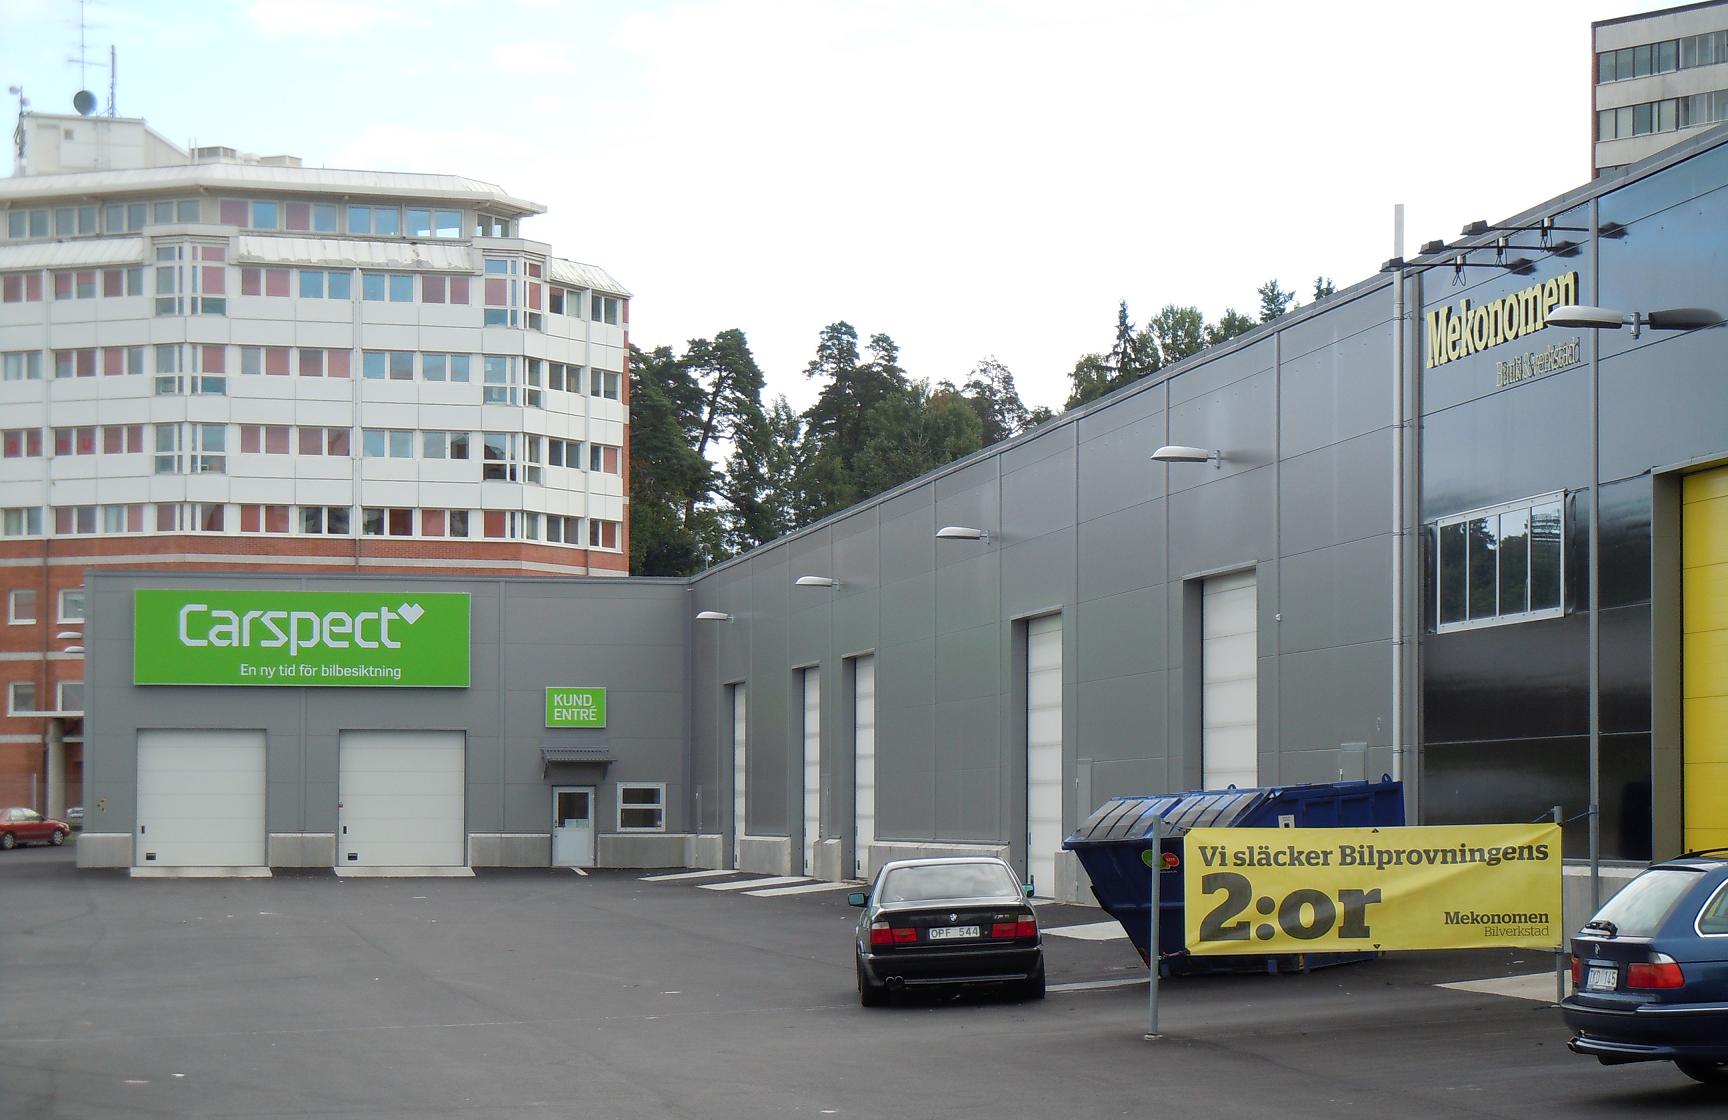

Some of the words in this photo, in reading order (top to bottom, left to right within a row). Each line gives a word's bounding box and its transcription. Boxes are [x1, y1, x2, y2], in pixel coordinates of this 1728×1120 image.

[1426, 271, 1577, 368] Mekonomen
[178, 603, 402, 656] Carspect
[240, 663, 257, 676] En
[260, 666, 276, 679] ny
[278, 663, 296, 677] tid
[299, 663, 318, 677] för
[321, 663, 402, 680] bilbesiktning
[553, 693, 593, 707] KUND
[553, 704, 597, 721] ENTRÉ
[1198, 845, 1228, 867] Vi
[1232, 845, 1334, 867] släcker
[1338, 843, 1549, 870] Bilprovningens
[1199, 871, 1382, 942] 2:or
[1444, 910, 1550, 925] Mekonomen
[931, 928, 951, 938] OPF
[959, 927, 978, 937] 544
[1483, 924, 1550, 938] Bilverkstad
